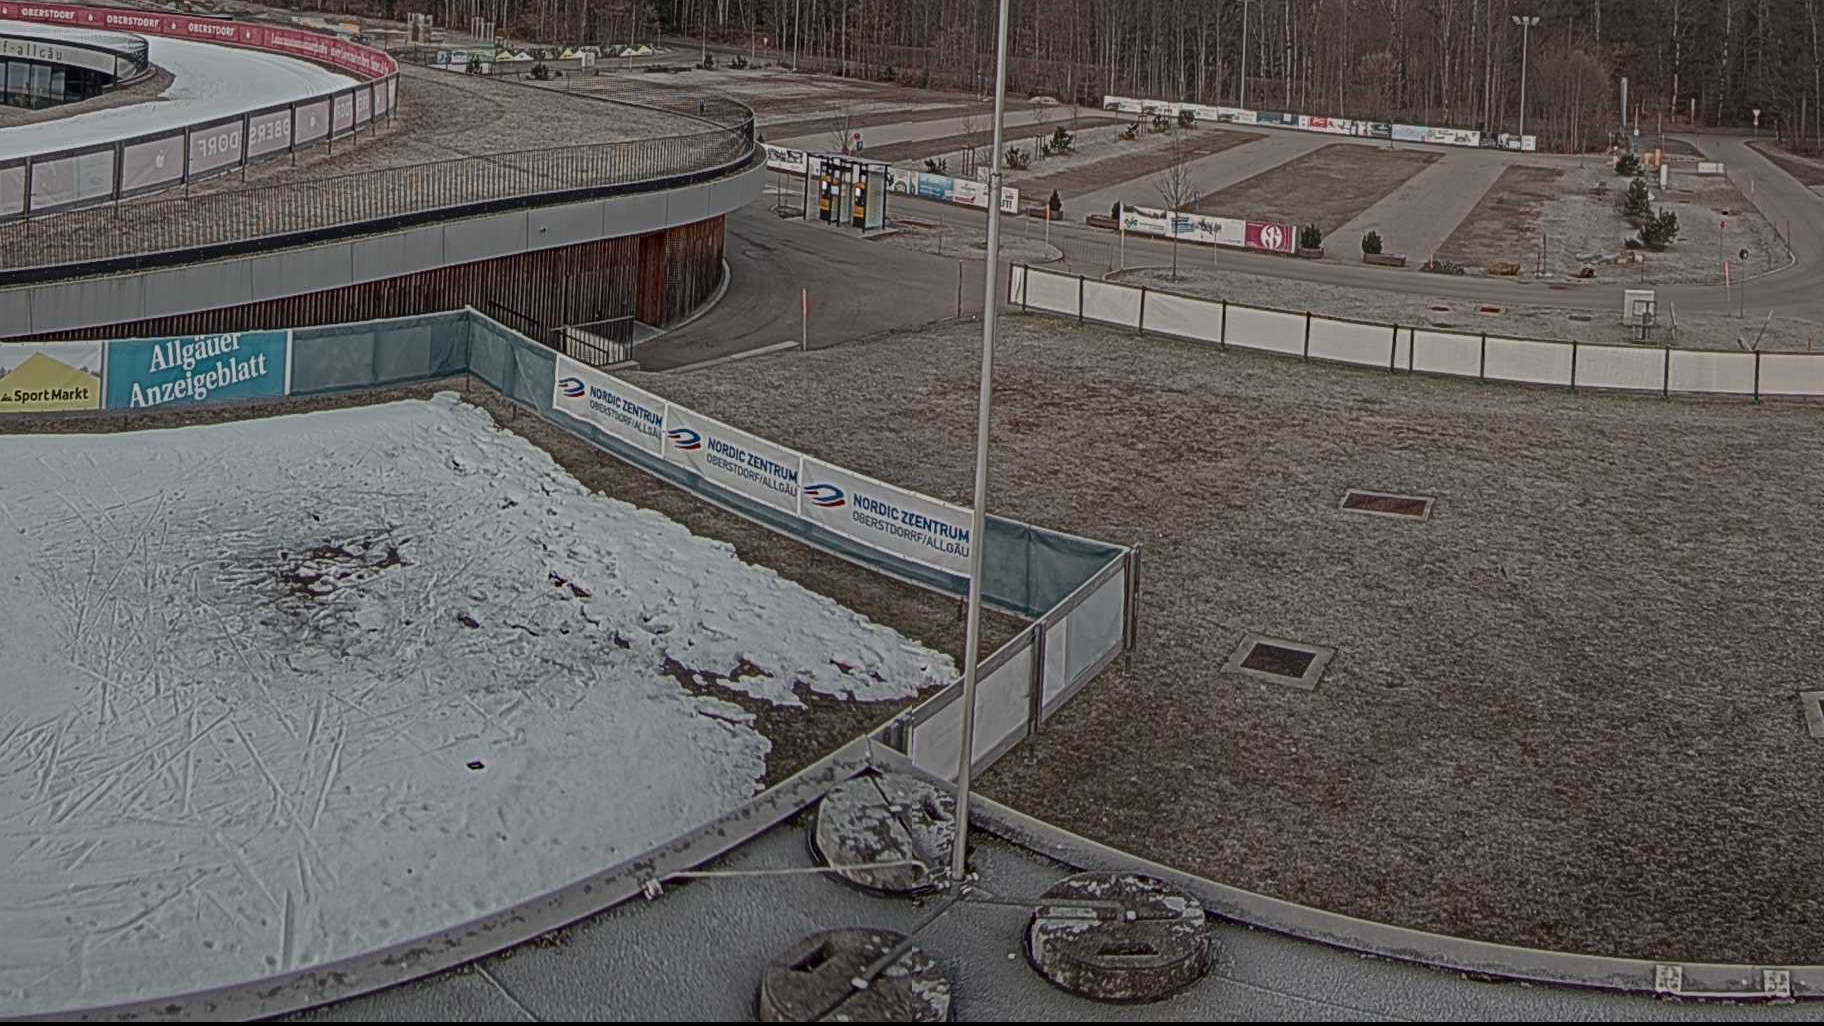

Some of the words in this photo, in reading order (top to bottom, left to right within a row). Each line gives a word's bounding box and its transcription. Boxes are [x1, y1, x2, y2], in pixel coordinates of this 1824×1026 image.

[21, 8, 75, 20] OBERSTDORF
[106, 14, 160, 28] OBERSTDORF
[188, 23, 236, 37] OBERSTDORF
[149, 332, 241, 374] Allgäuer
[130, 352, 268, 408] Anzeigeblatt
[14, 389, 50, 404] Sport
[51, 387, 89, 401] Markt
[590, 385, 621, 408] NORDIC
[622, 399, 663, 428] ZENTRUM
[707, 437, 746, 463] NORDIC
[747, 453, 798, 484] ZENTRUM
[853, 493, 900, 521] NORDIC
